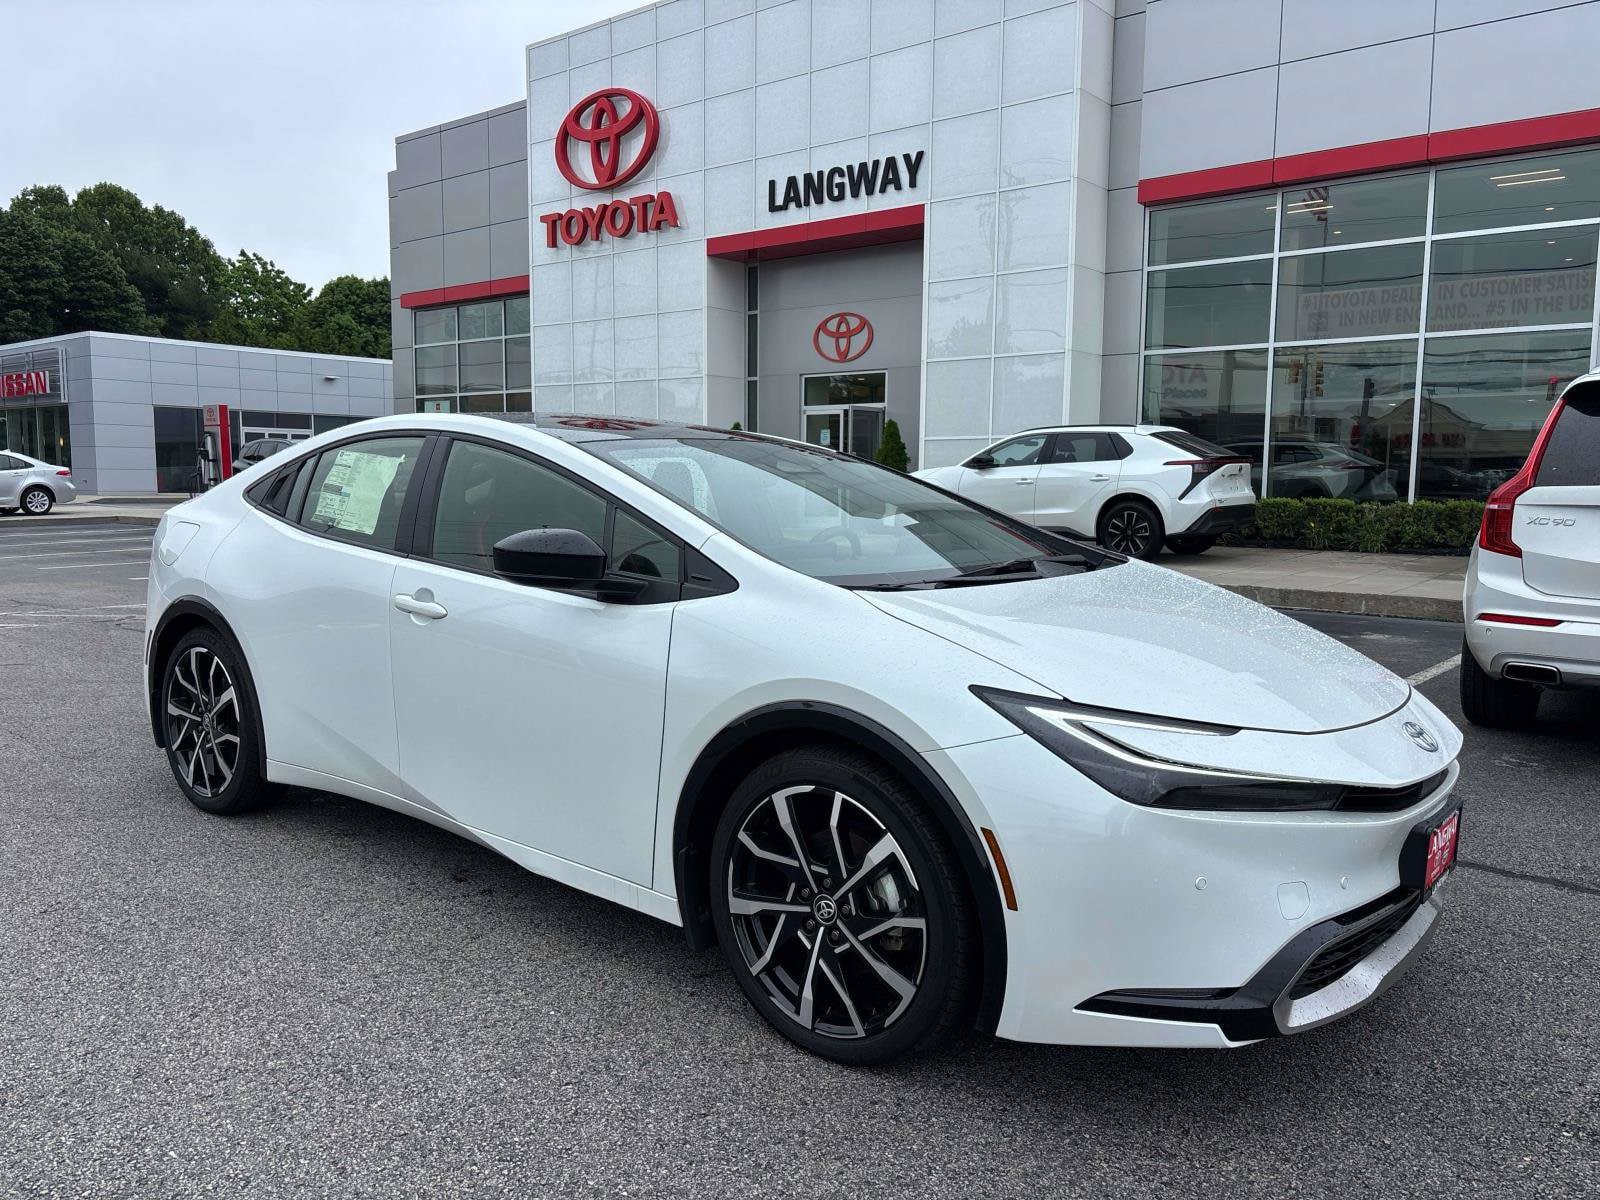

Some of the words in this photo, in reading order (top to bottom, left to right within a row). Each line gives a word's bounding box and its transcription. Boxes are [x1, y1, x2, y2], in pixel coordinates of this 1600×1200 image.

[768, 150, 924, 213] LANGWAY
[540, 191, 680, 248] TOYOTA
[1322, 289, 1376, 310] TOYOTA
[1381, 287, 1422, 304] DEAL
[1438, 284, 1454, 301] IN
[1459, 276, 1542, 298] CUSTOMER
[1338, 311, 1355, 327] IN
[1358, 308, 1391, 326] NEW
[1485, 299, 1506, 316] #5
[1511, 296, 1529, 316] IN
[1533, 295, 1564, 314] THE
[1568, 292, 1593, 311] US
[0, 370, 50, 398] ISSAN
